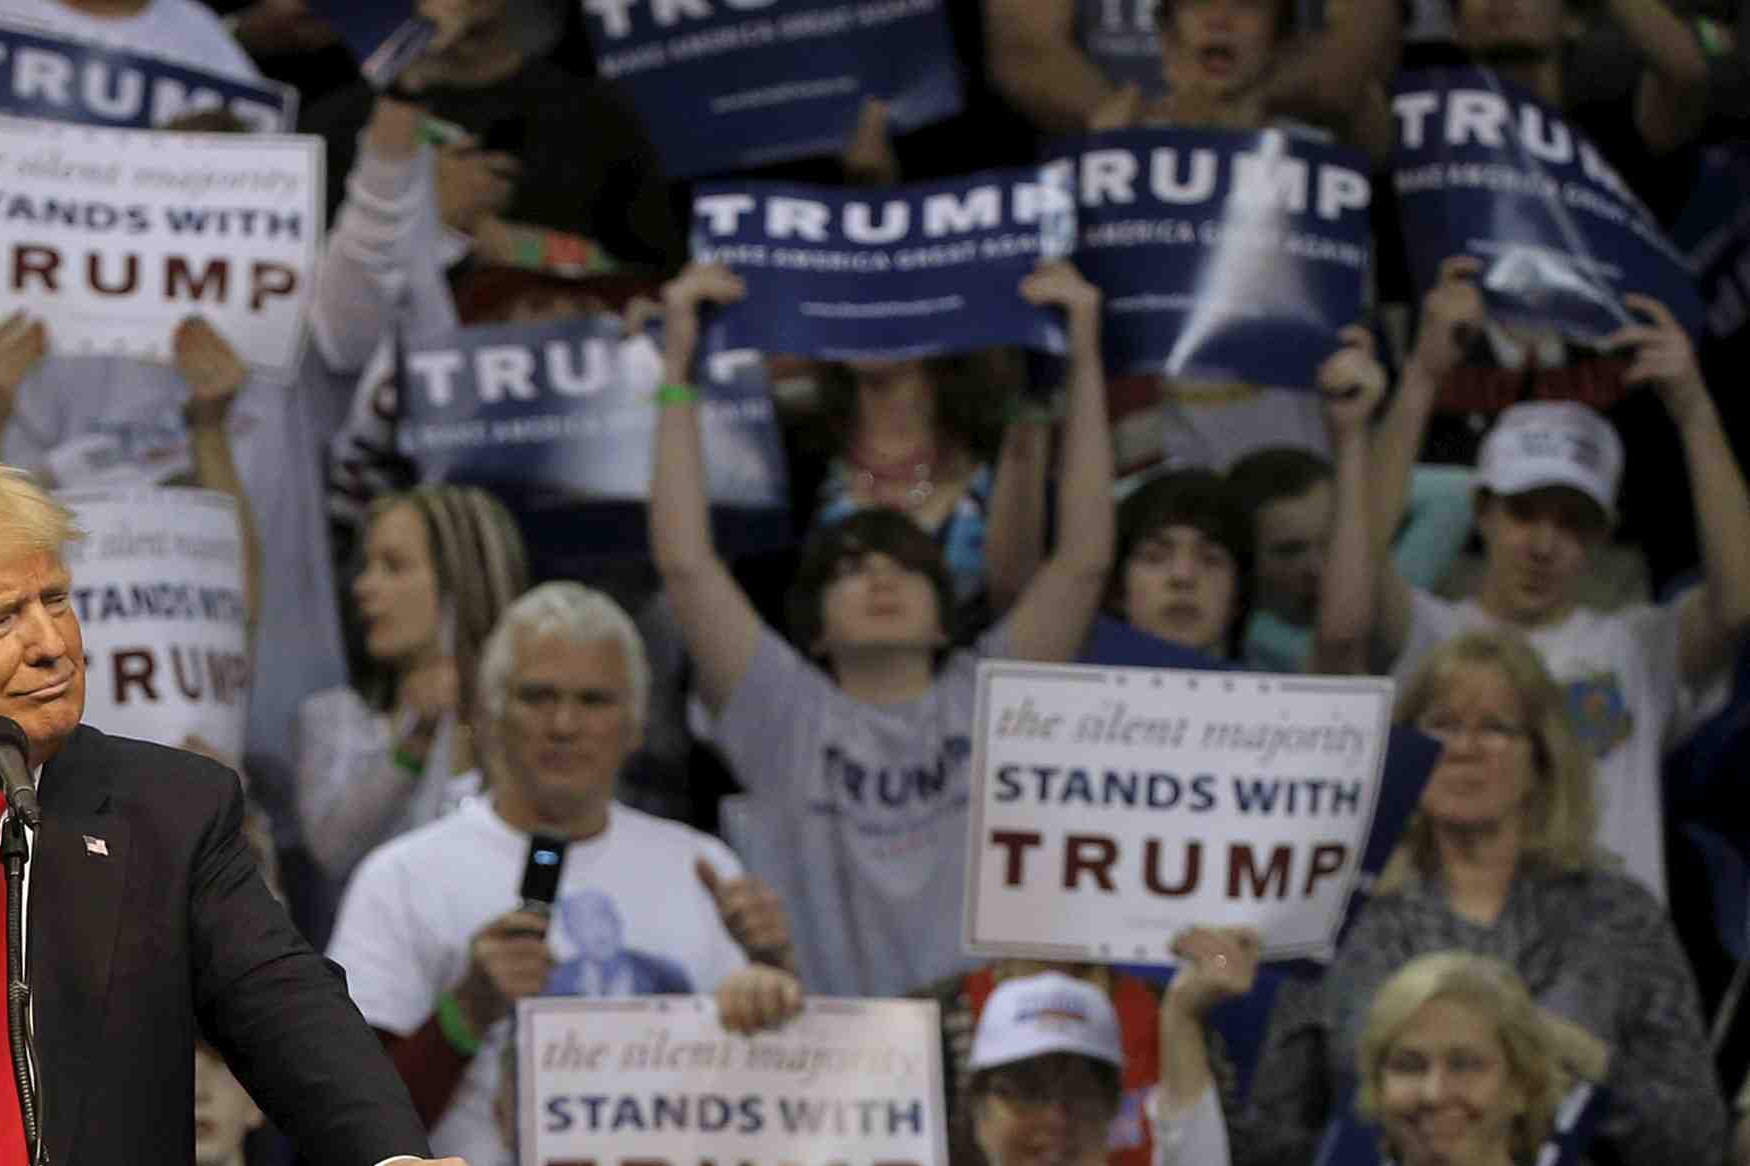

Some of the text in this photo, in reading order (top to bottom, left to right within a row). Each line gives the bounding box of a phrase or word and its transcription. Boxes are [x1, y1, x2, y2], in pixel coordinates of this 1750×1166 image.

[1392, 88, 1638, 203] TRU
[164, 205, 302, 240] WITH
[995, 695, 1065, 740] the
[1071, 702, 1191, 750] silent
[994, 764, 1363, 816] STANDS WITH
[992, 829, 1349, 902] TRUMP
[541, 1029, 608, 1071] the
[617, 1029, 731, 1071] silent
[545, 1095, 923, 1135] STANDS WITH
